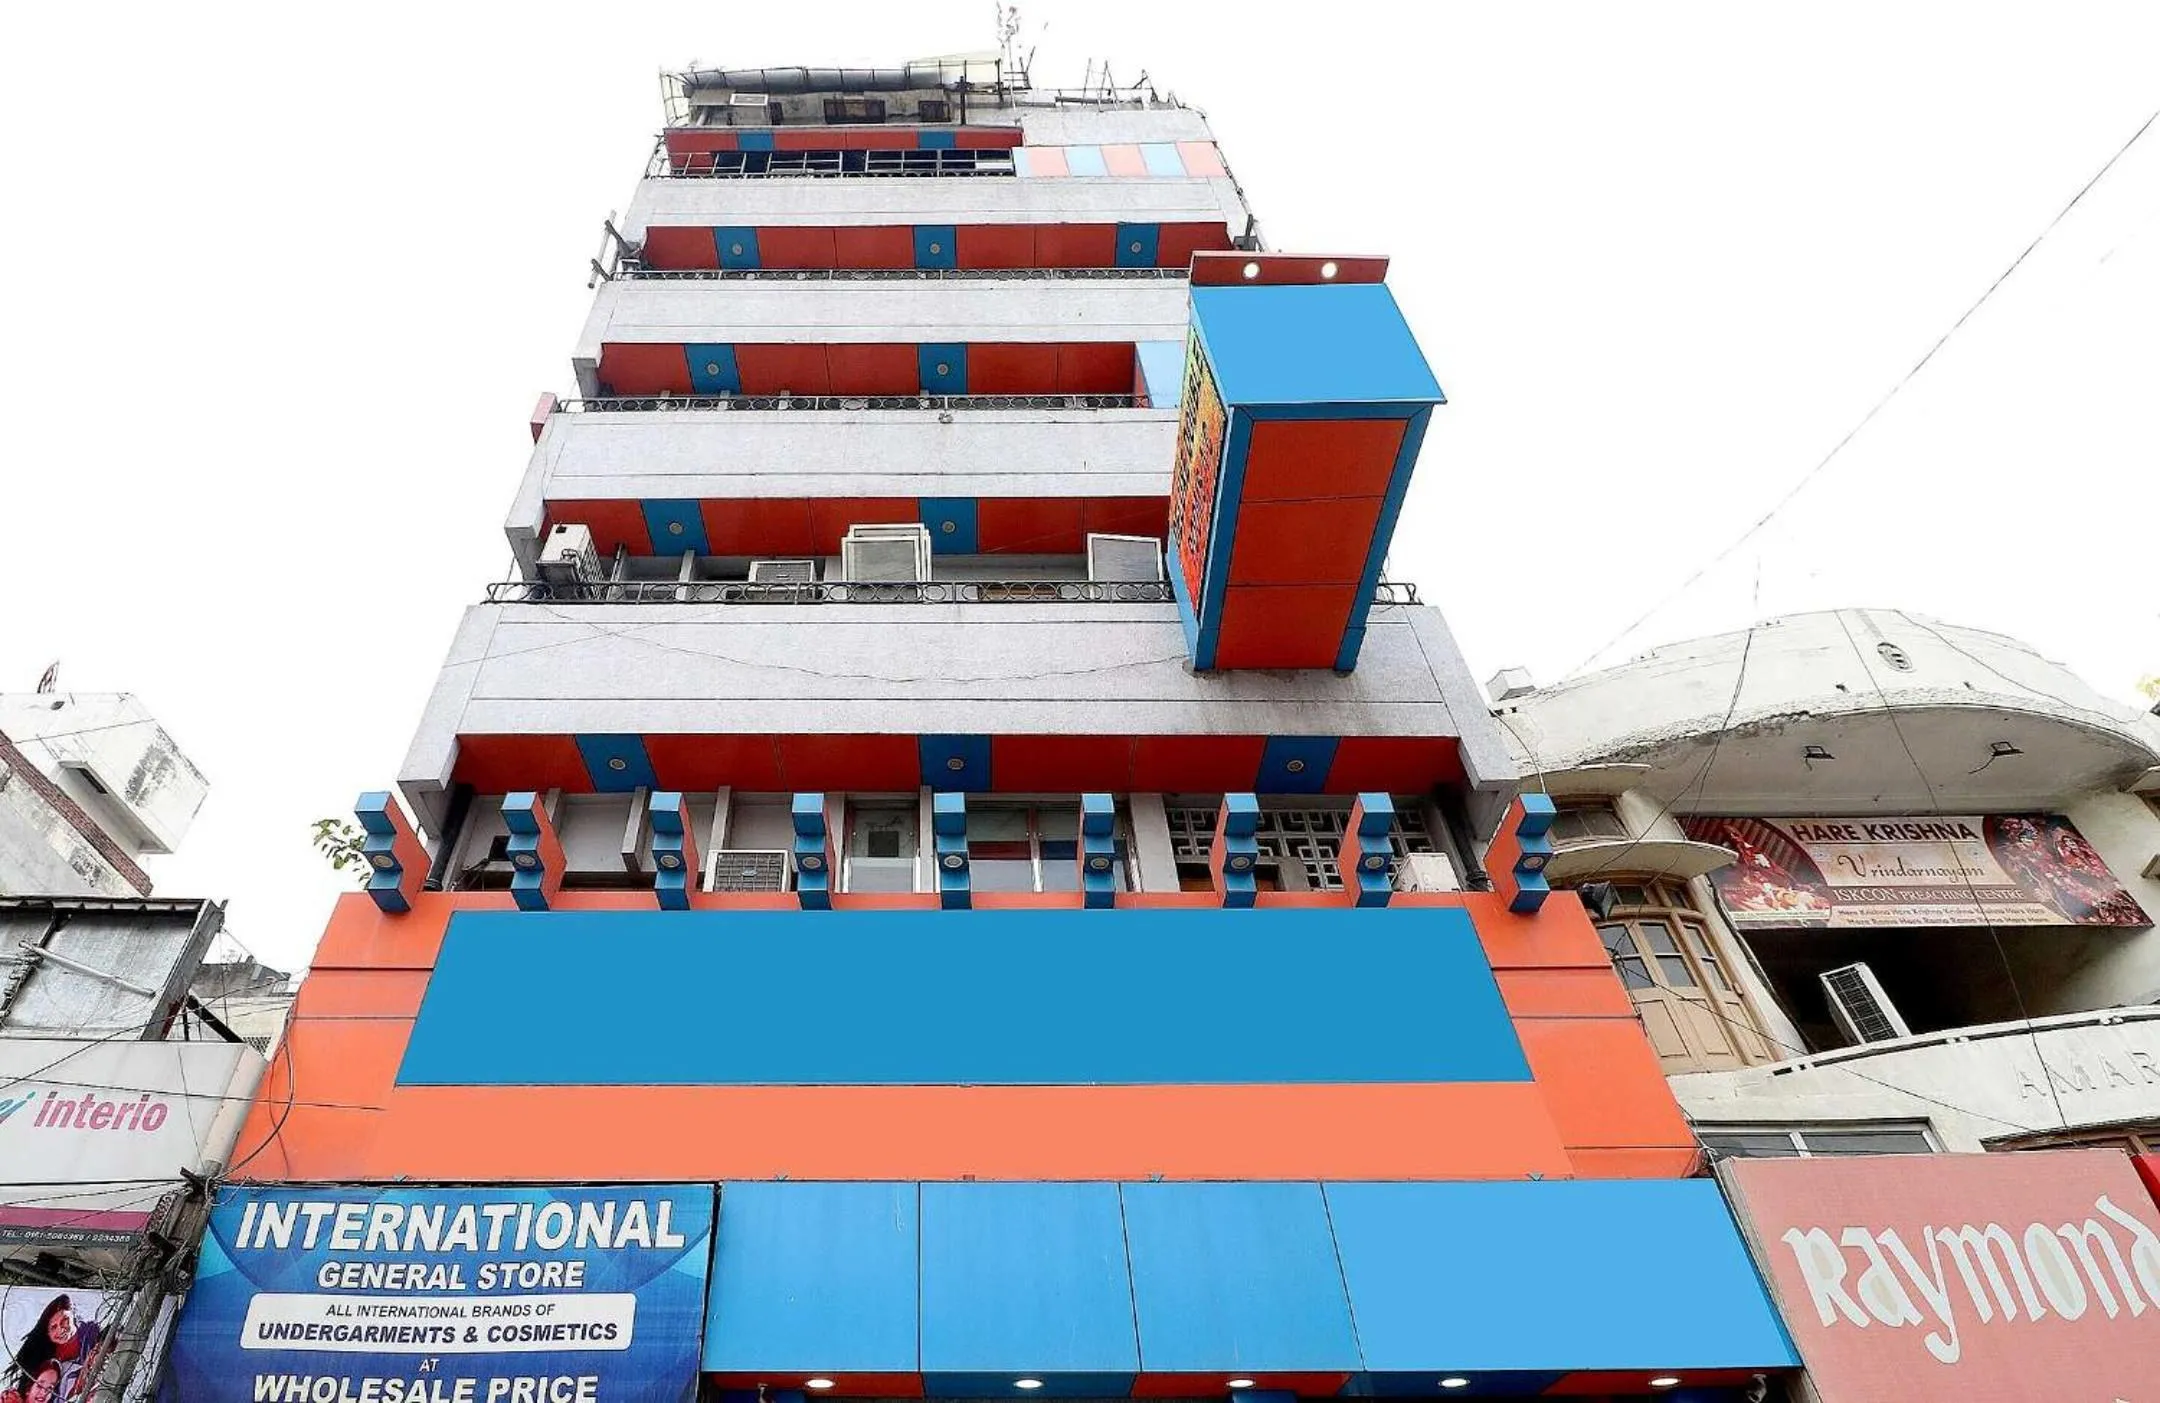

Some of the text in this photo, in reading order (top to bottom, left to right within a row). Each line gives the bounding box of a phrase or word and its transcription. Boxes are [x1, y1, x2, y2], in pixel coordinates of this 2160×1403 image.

[1790, 823, 1979, 841] HARE KRISHNA
[1833, 888, 2026, 901] ISKCON PREACHING CENTRE
[34, 1091, 168, 1131] interio
[235, 1201, 686, 1253] INTERNATIONAL
[316, 1260, 587, 1291] GENERAL STORE
[325, 1303, 555, 1319] ALL INTERNATIONAL BRANDS OF
[258, 1322, 618, 1344] UNDERGARMENTS & COSMETICS
[419, 1359, 439, 1372] AT
[253, 1374, 599, 1403] WHOLESALE PRICE
